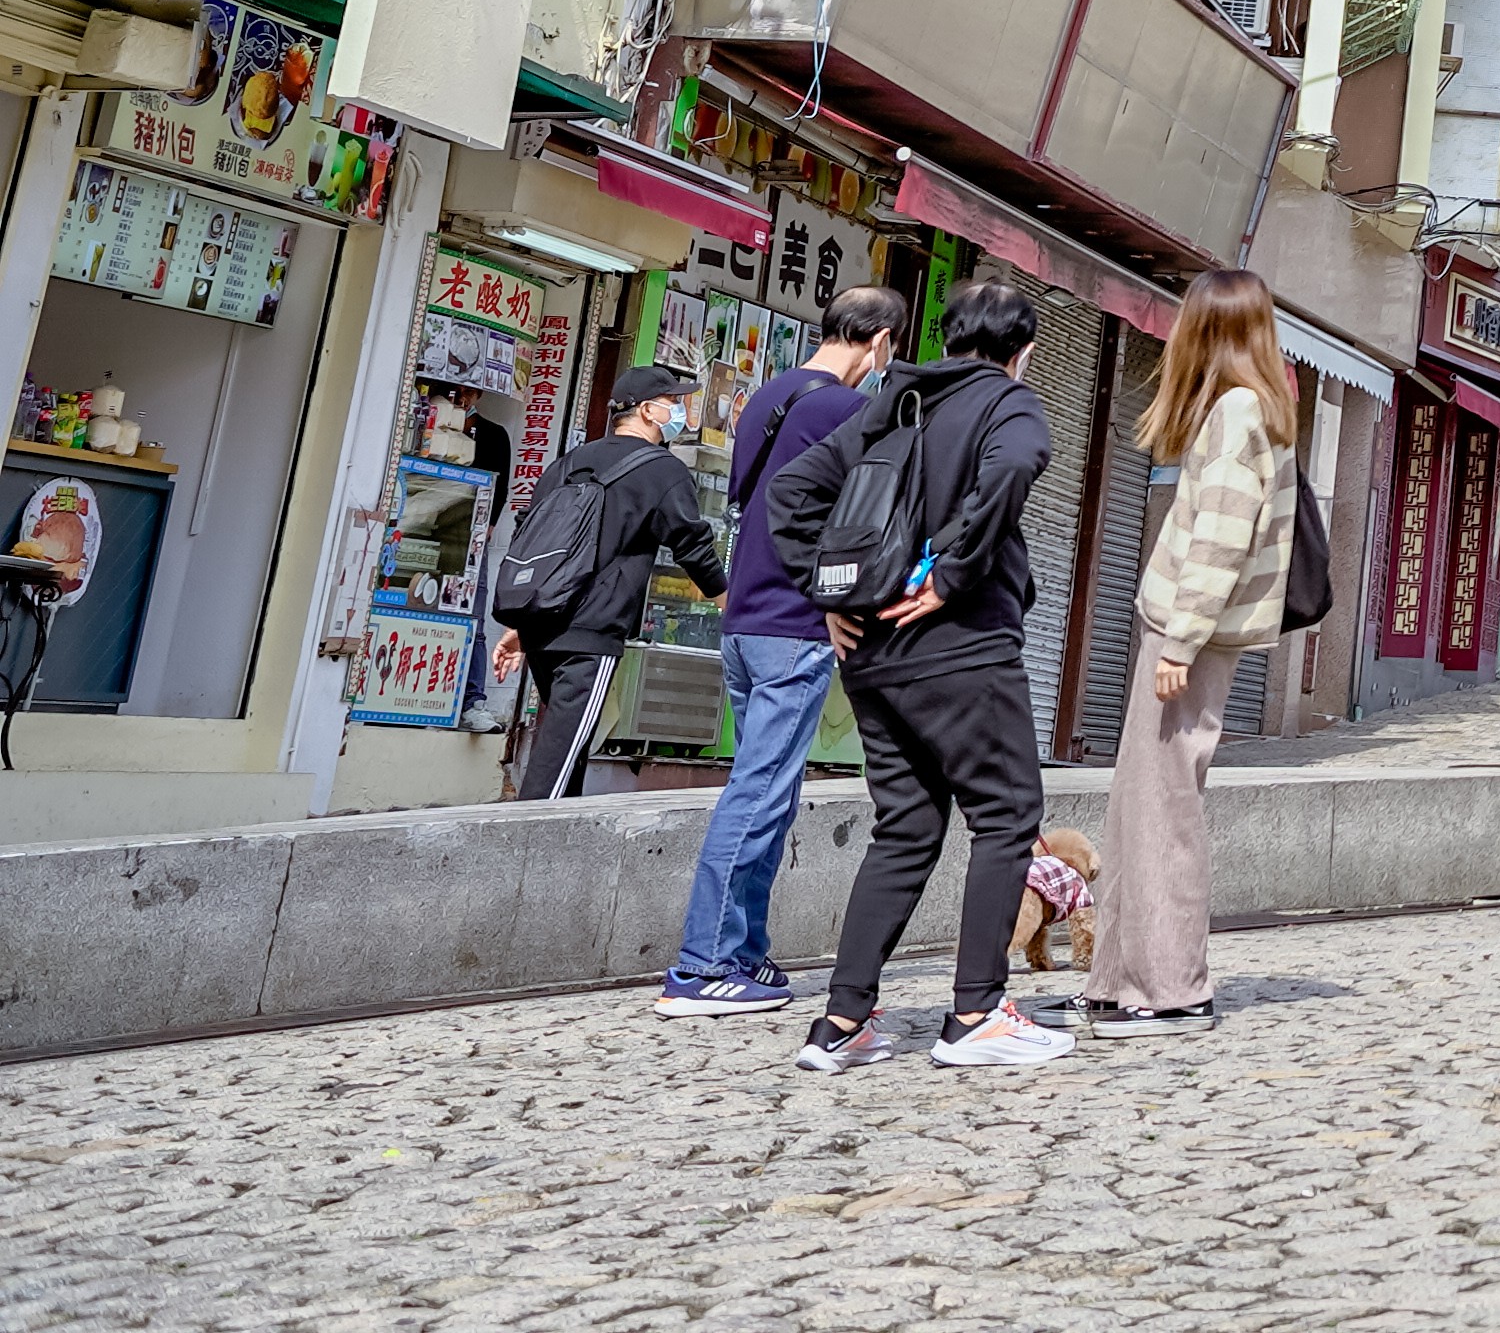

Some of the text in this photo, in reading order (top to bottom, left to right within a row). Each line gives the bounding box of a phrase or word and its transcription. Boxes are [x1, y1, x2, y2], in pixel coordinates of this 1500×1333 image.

[133, 109, 197, 166] 豬扒包
[435, 261, 532, 328] 老酸奶
